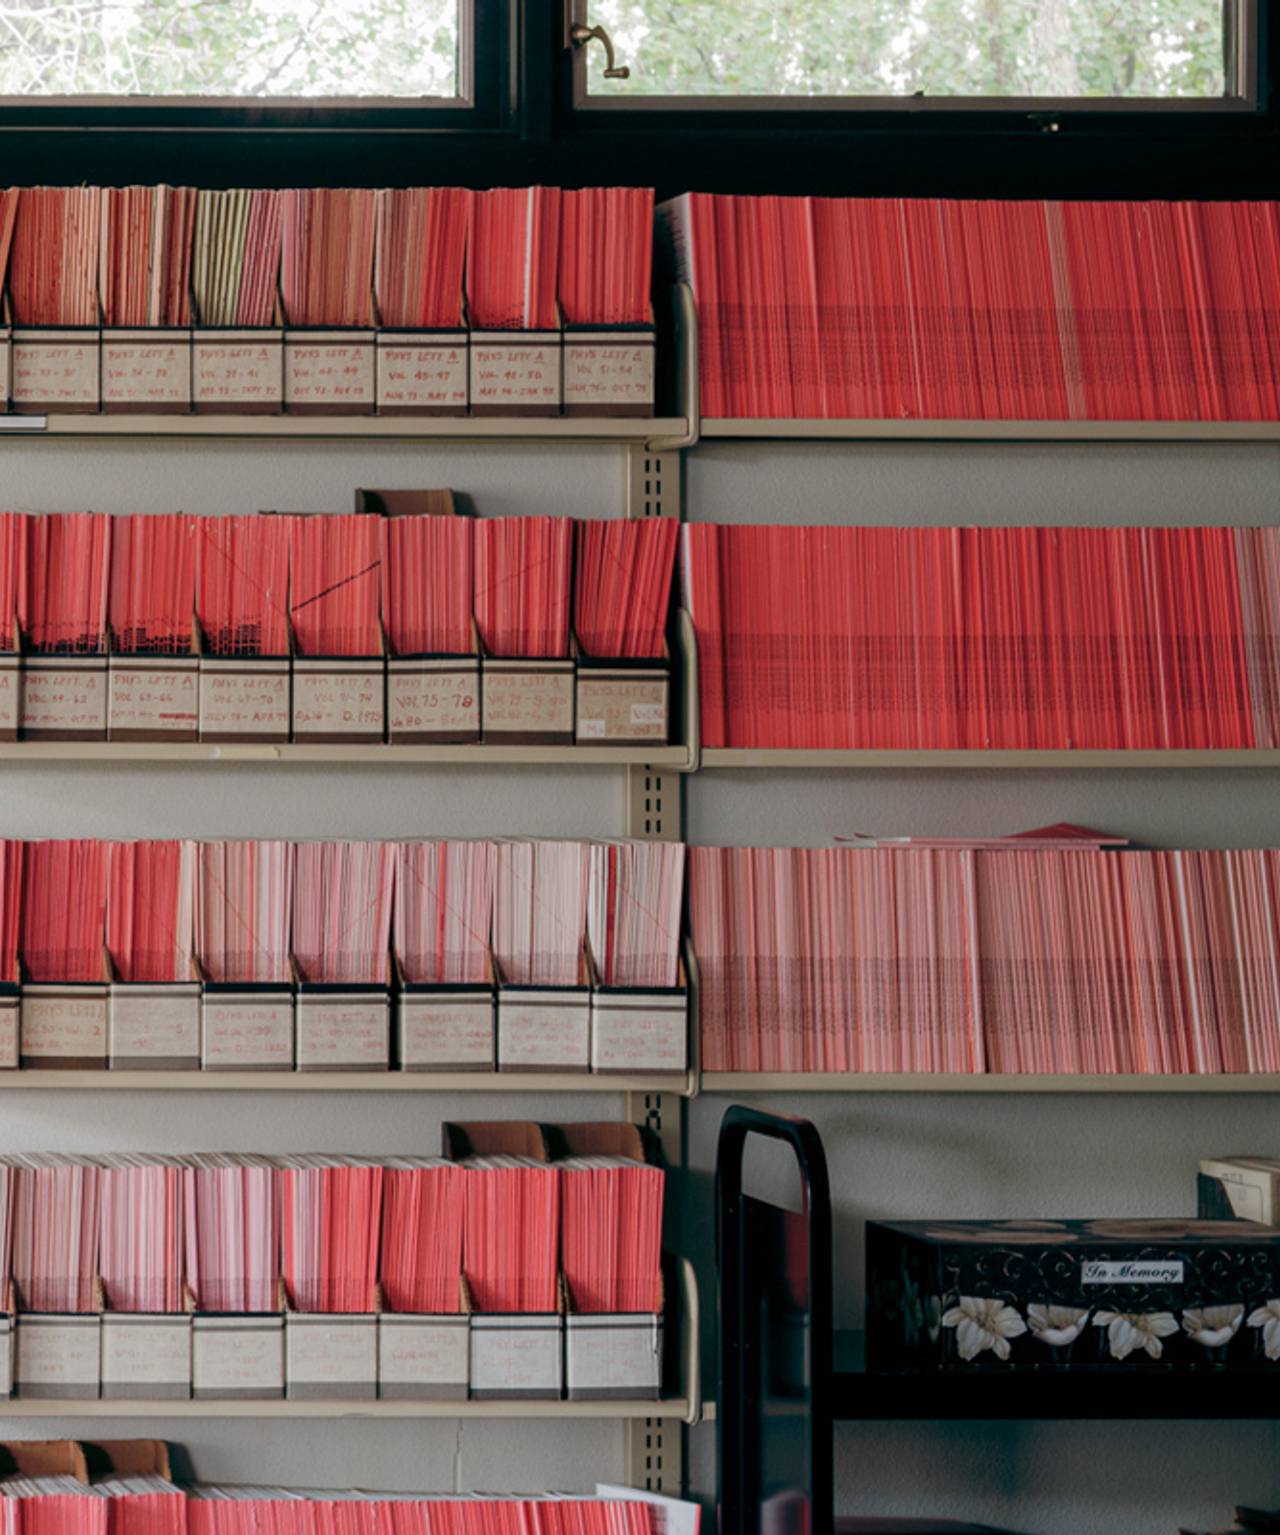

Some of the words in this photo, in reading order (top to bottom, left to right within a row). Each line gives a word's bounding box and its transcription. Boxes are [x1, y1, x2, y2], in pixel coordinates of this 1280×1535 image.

[114, 673, 142, 686] PHYS
[148, 674, 177, 686] LETT
[1085, 1263, 1108, 1281] In
[1111, 1263, 1179, 1283] Memory
